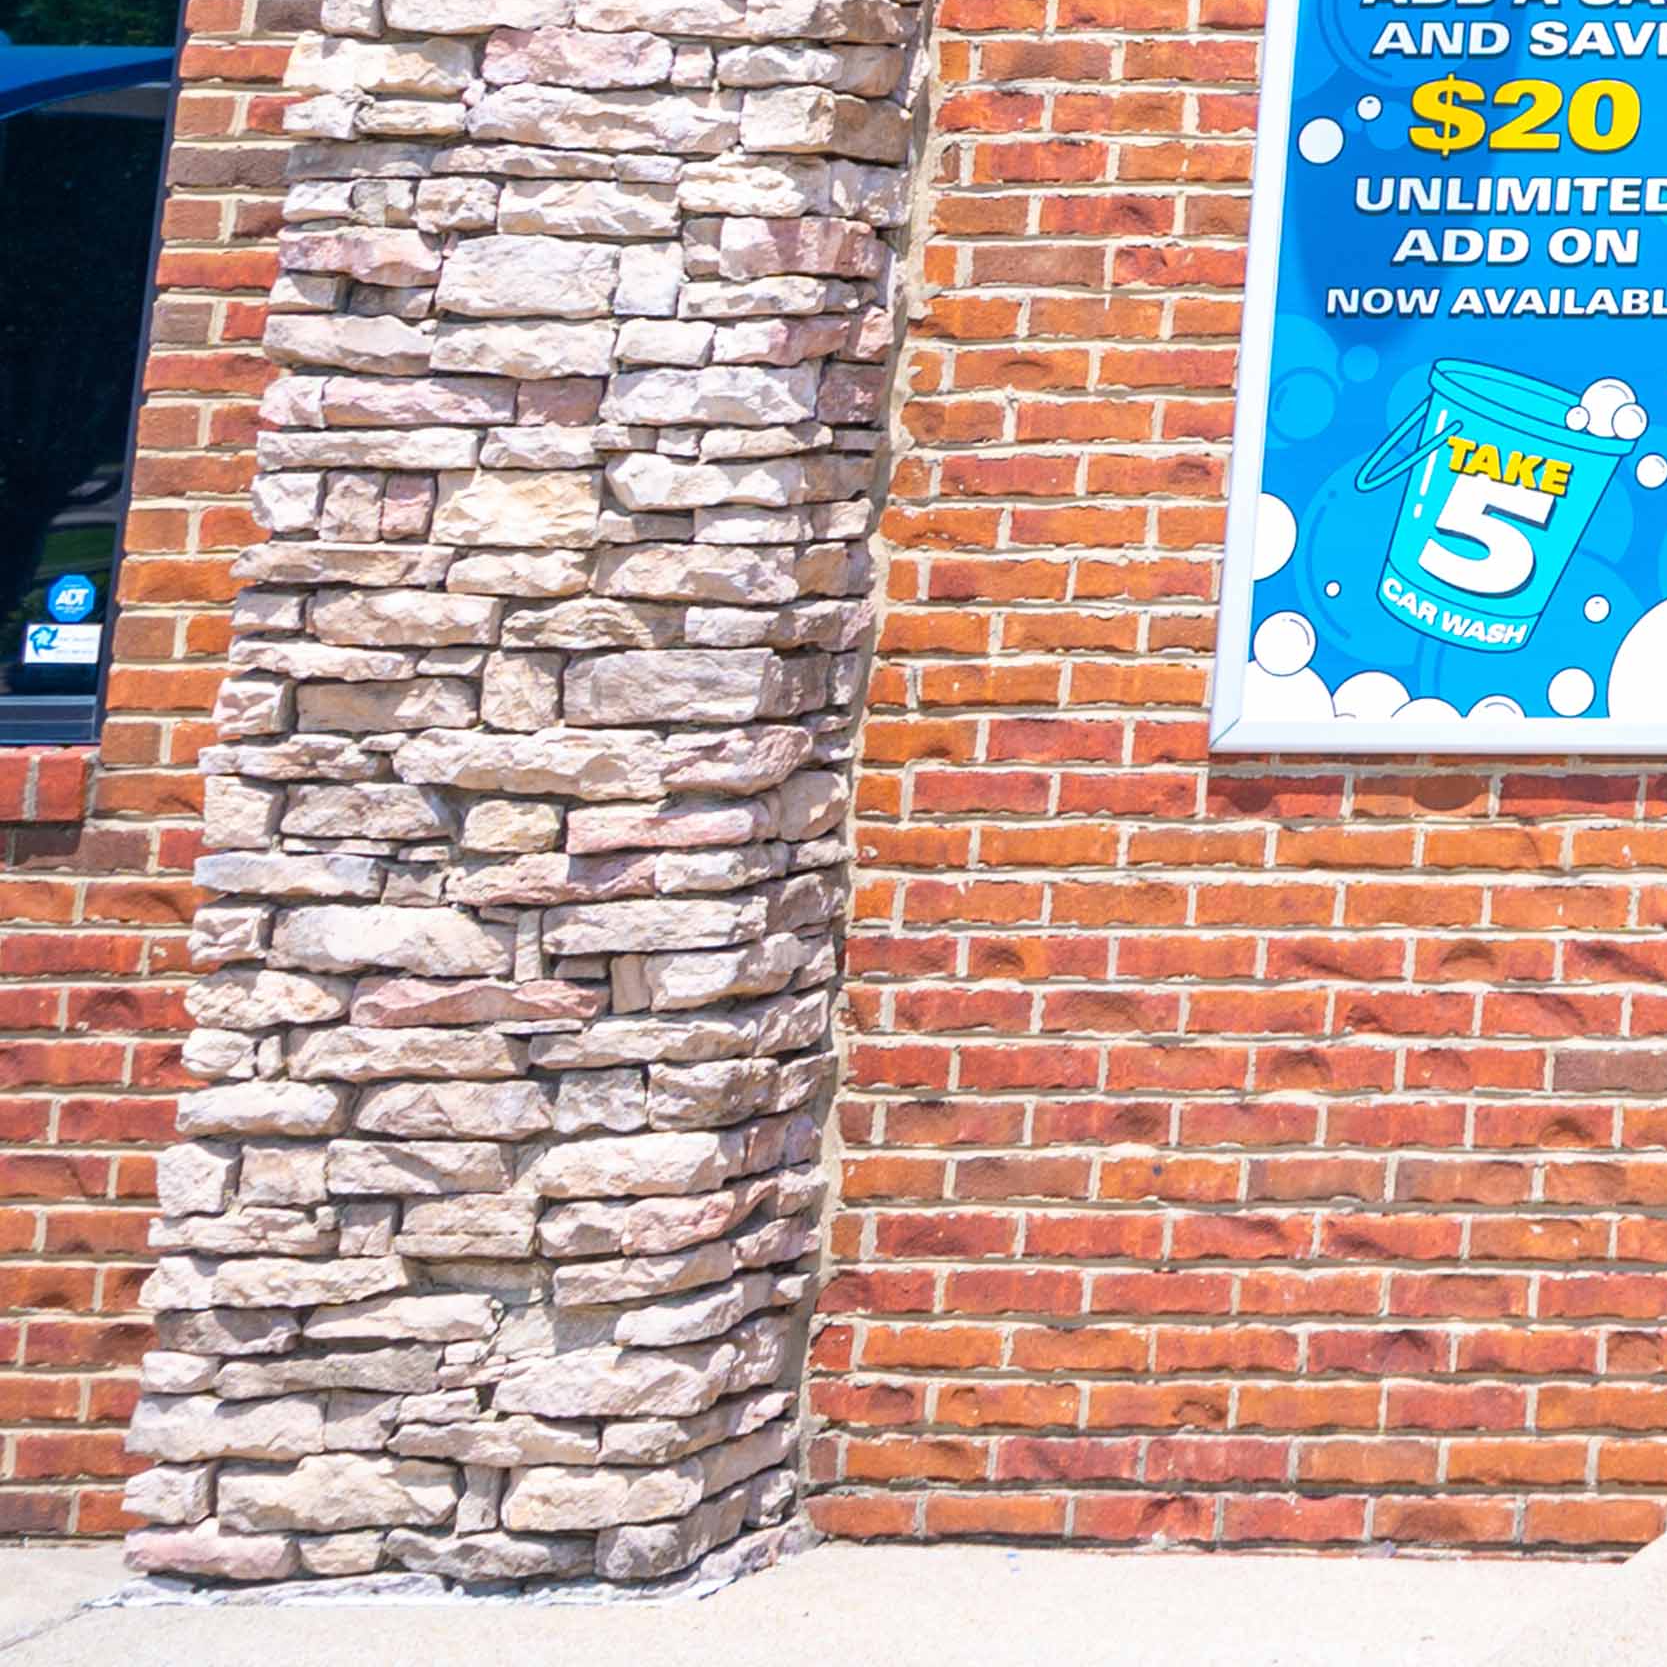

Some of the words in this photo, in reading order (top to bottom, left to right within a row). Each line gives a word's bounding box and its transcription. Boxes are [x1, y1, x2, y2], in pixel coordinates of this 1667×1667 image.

[1372, 20, 1512, 58] AND
[1408, 73, 1643, 158] $20
[1391, 228, 1533, 265] ADD
[1546, 228, 1640, 265] ON
[1325, 287, 1441, 317] NOW
[1446, 435, 1575, 496] TAKE
[1418, 474, 1556, 597] 5
[55, 588, 90, 605] ADT
[1382, 577, 1438, 623] CAR
[1440, 612, 1530, 646] WASH
